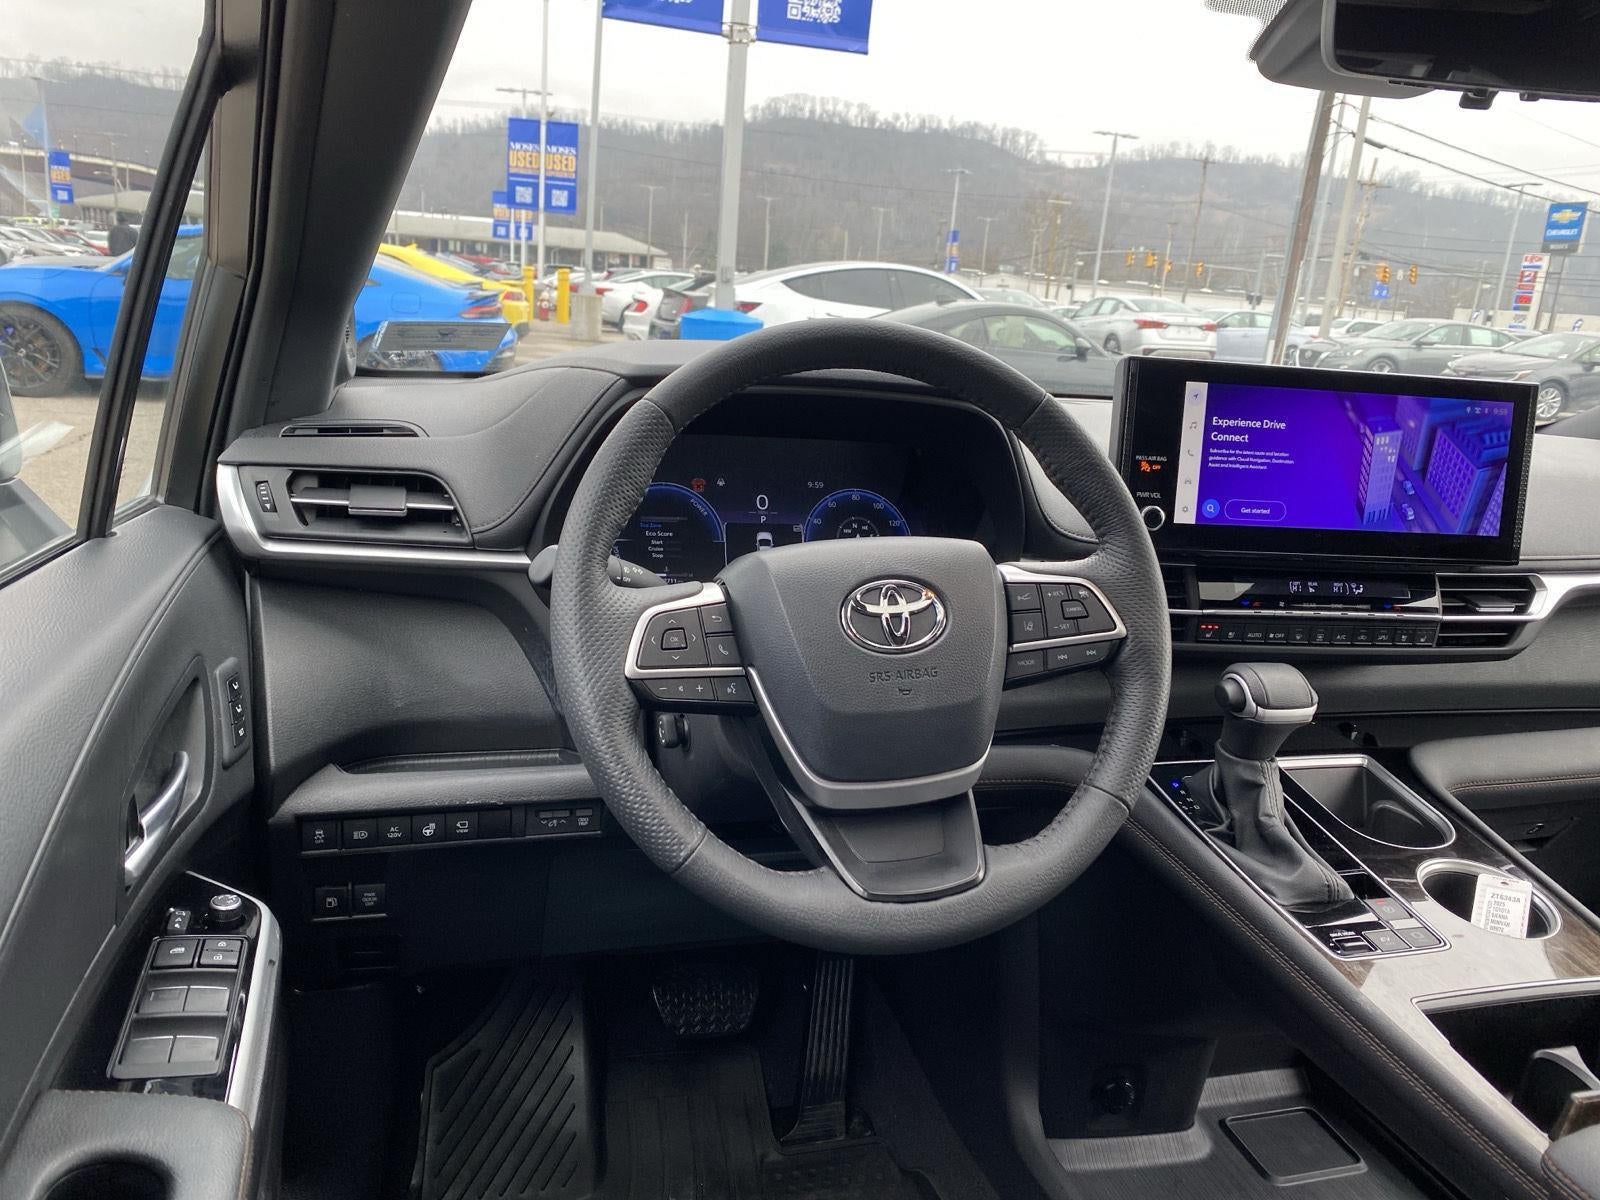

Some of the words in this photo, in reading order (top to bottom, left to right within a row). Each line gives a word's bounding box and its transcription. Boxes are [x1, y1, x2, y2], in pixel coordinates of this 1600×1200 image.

[547, 145, 577, 155] MOSES
[509, 151, 540, 169] USED
[545, 154, 576, 172] USED
[1546, 229, 1579, 237] CHEVROLET
[1212, 416, 1261, 428] Experience
[1263, 419, 1287, 430] Drive
[1211, 431, 1249, 443] Connect
[807, 481, 824, 489] 9:59
[872, 502, 885, 510] 100
[760, 515, 767, 524] P
[889, 519, 900, 527] 120
[869, 671, 891, 682] SRS
[895, 667, 938, 680] AIRBAG
